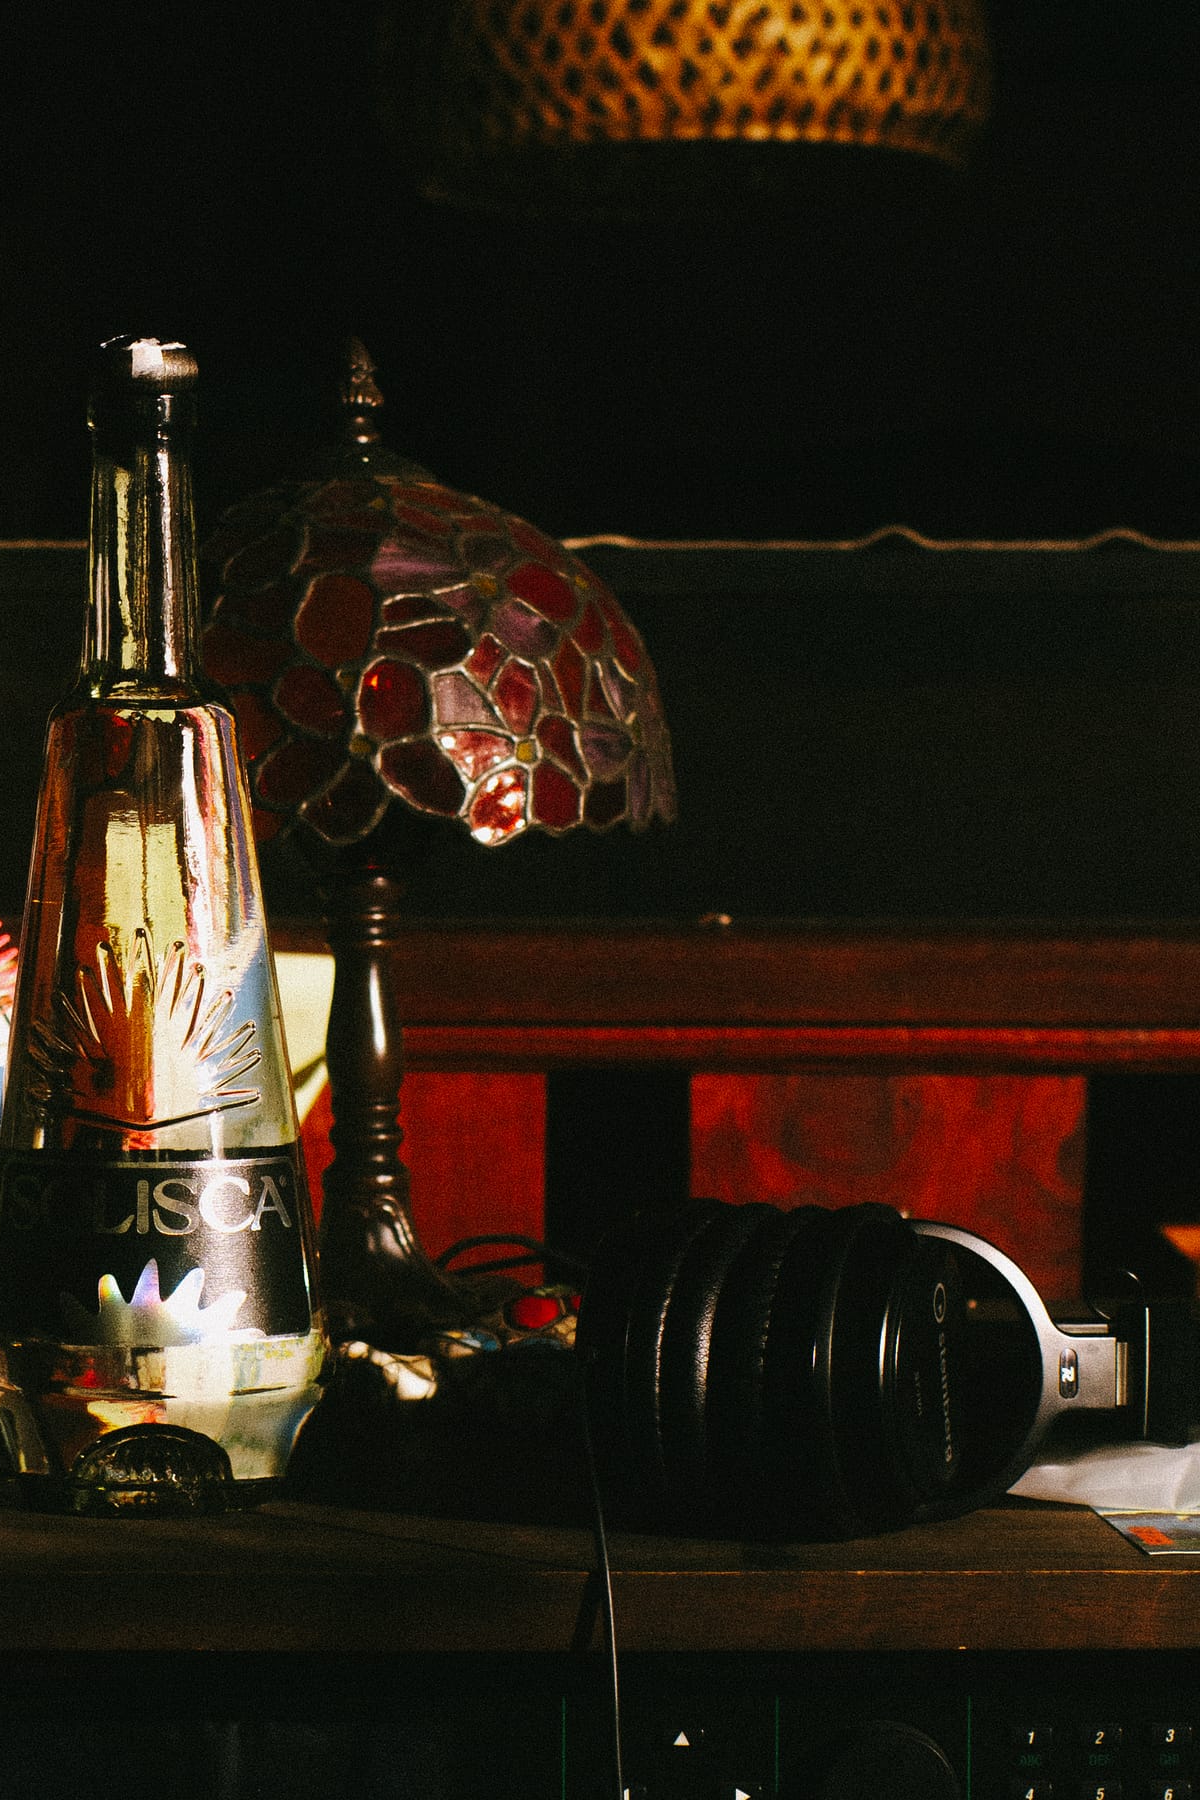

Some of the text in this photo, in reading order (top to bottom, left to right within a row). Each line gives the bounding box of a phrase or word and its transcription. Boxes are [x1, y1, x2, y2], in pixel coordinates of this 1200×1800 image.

[1061, 1366, 1075, 1383] R
[1027, 1730, 1036, 1746] 1
[1094, 1730, 1105, 1746] 2
[1164, 1727, 1176, 1744] 3
[1024, 1787, 1035, 1800] 4
[1095, 1787, 1106, 1800] 5
[1163, 1787, 1175, 1800] 6
